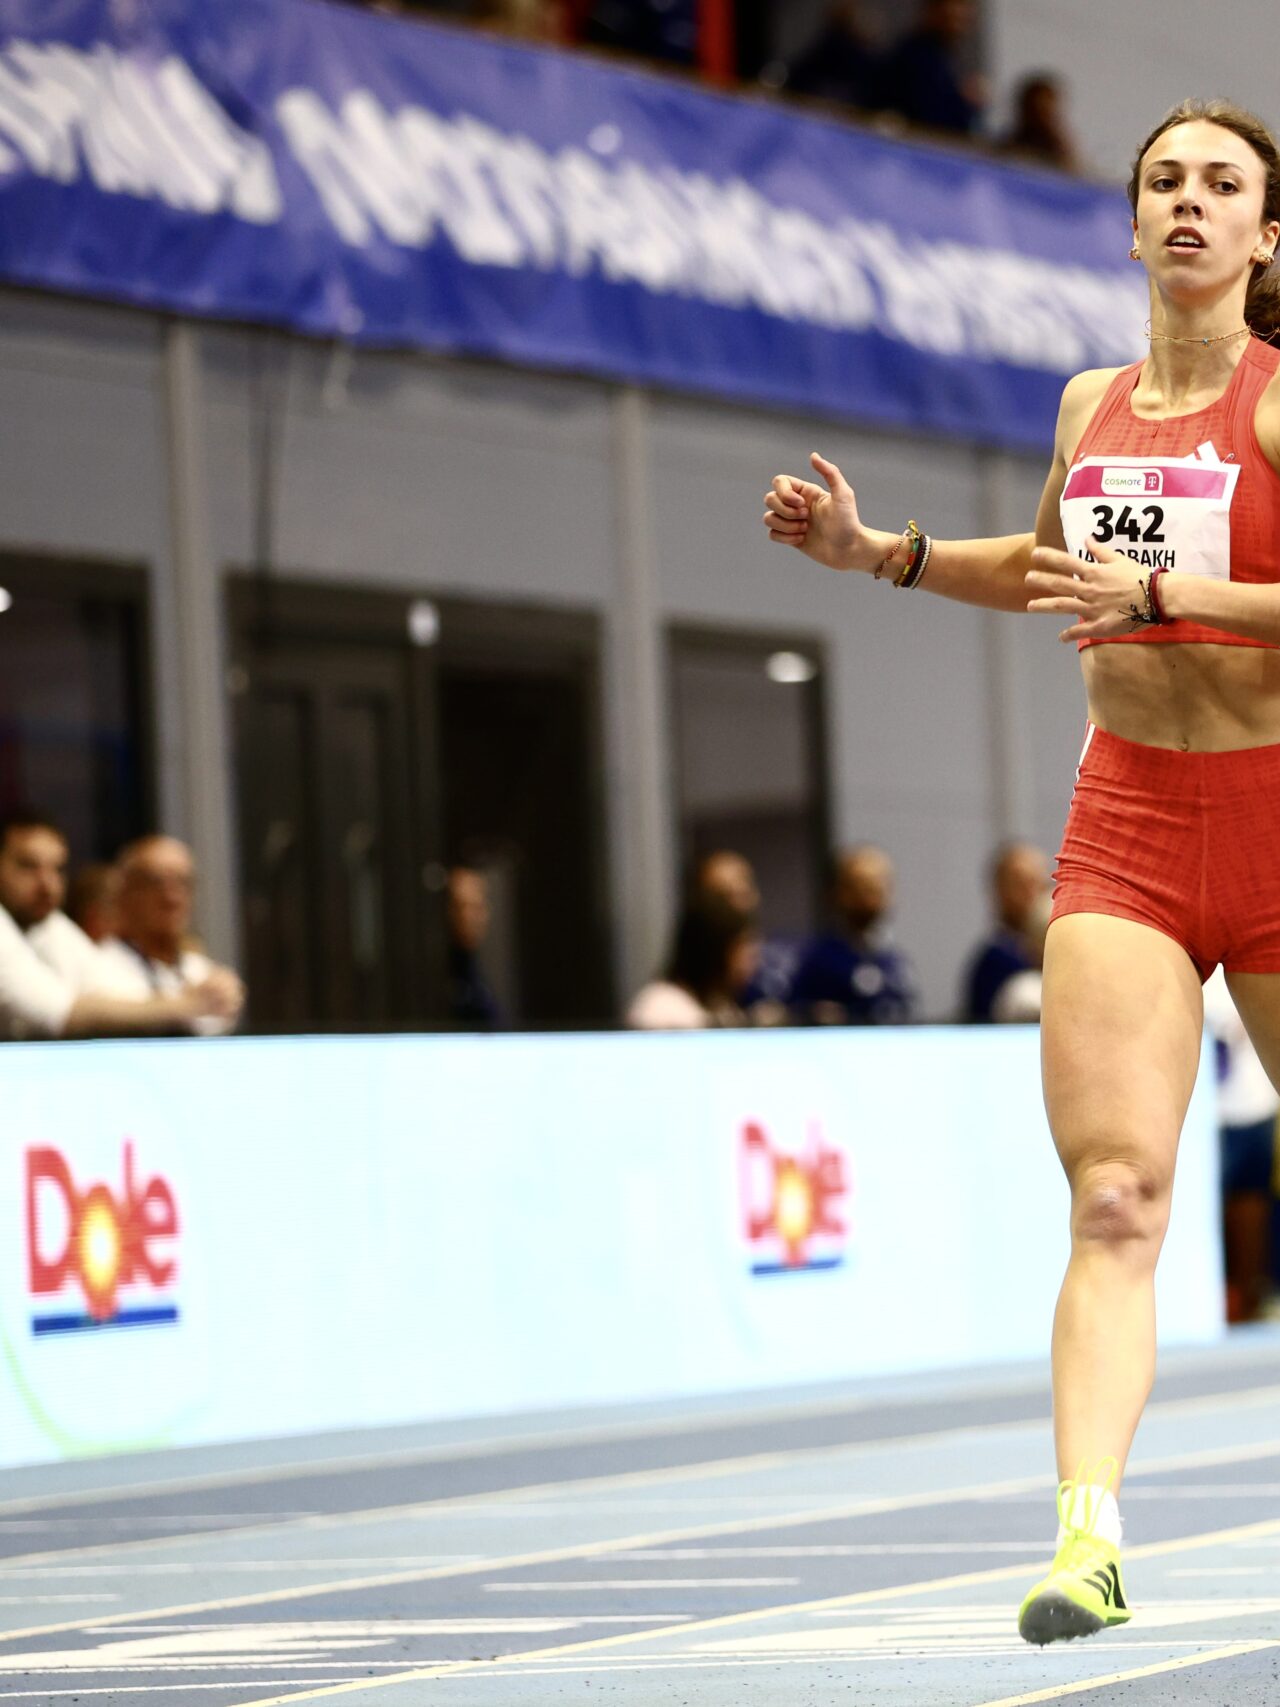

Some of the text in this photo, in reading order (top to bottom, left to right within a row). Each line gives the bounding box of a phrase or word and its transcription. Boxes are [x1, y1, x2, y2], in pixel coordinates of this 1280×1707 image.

[1104, 478, 1142, 486] COSMOTE
[1091, 505, 1165, 543] 342
[26, 1141, 179, 1312] Dole
